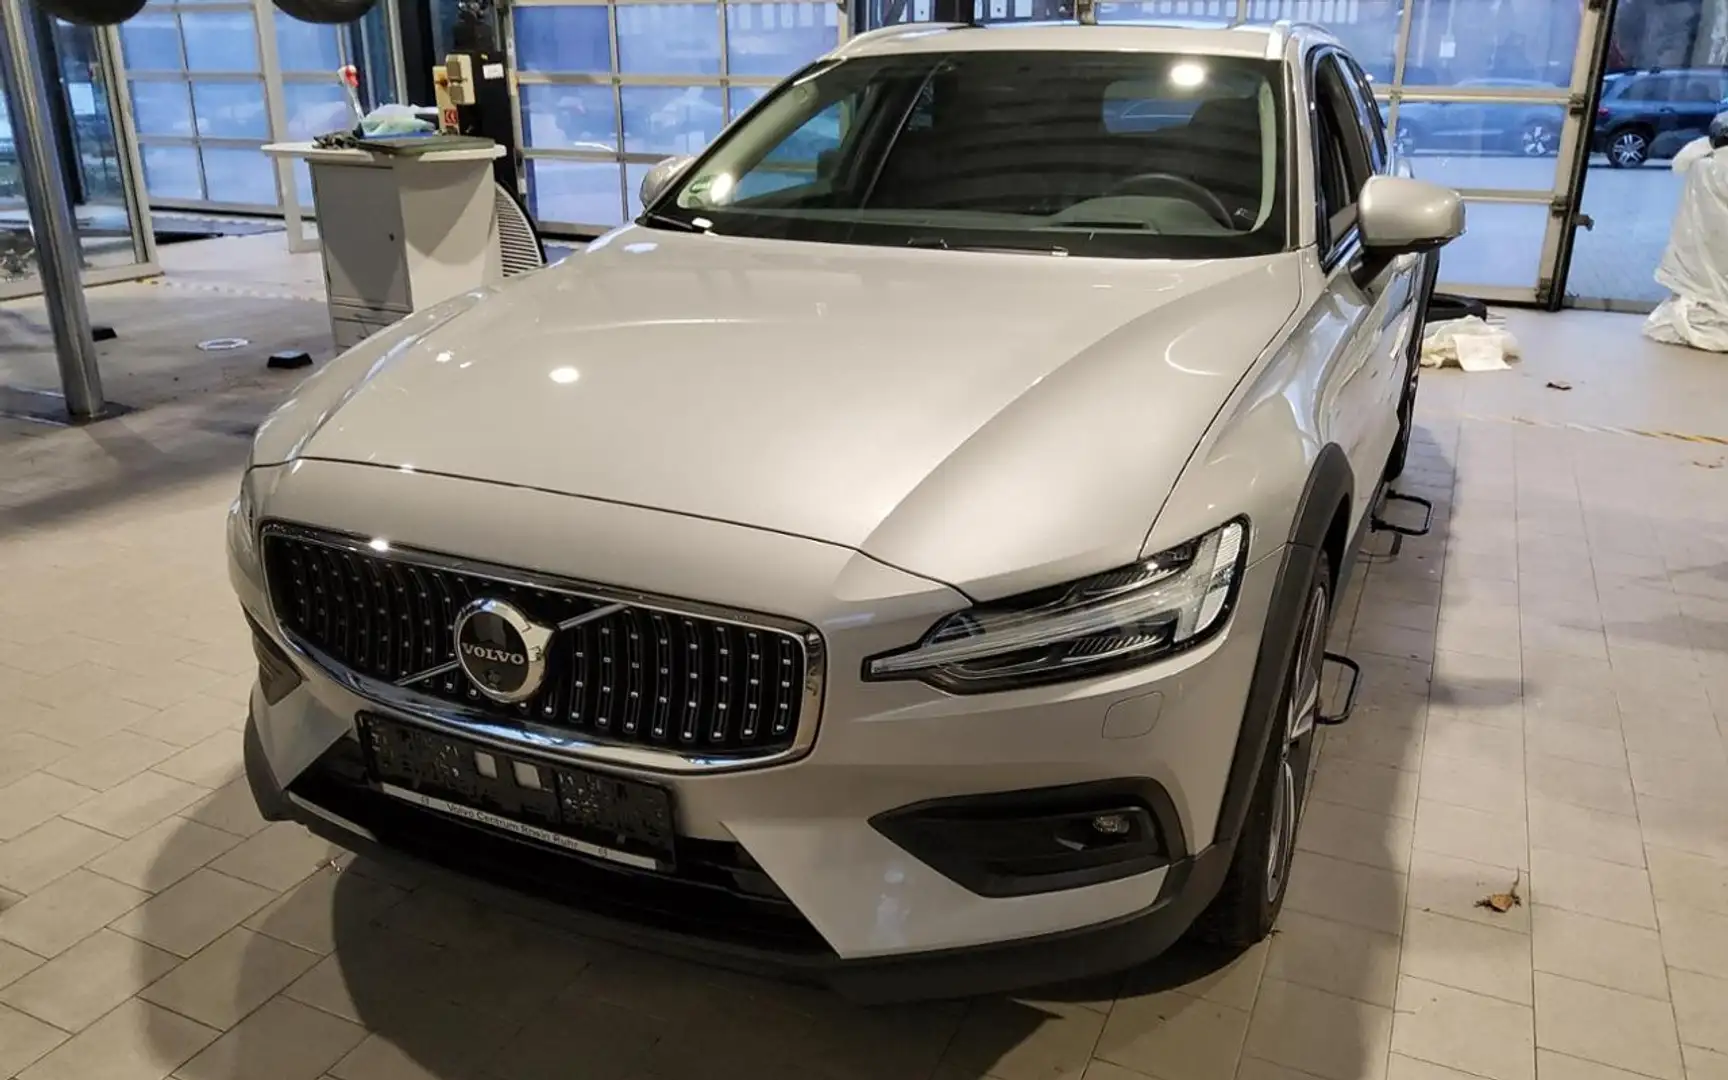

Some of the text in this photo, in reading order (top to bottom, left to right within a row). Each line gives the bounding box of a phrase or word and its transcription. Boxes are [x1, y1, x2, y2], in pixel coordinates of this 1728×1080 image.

[461, 642, 525, 665] VOLVO
[446, 803, 475, 818] Volvo
[476, 811, 518, 831] Centrum
